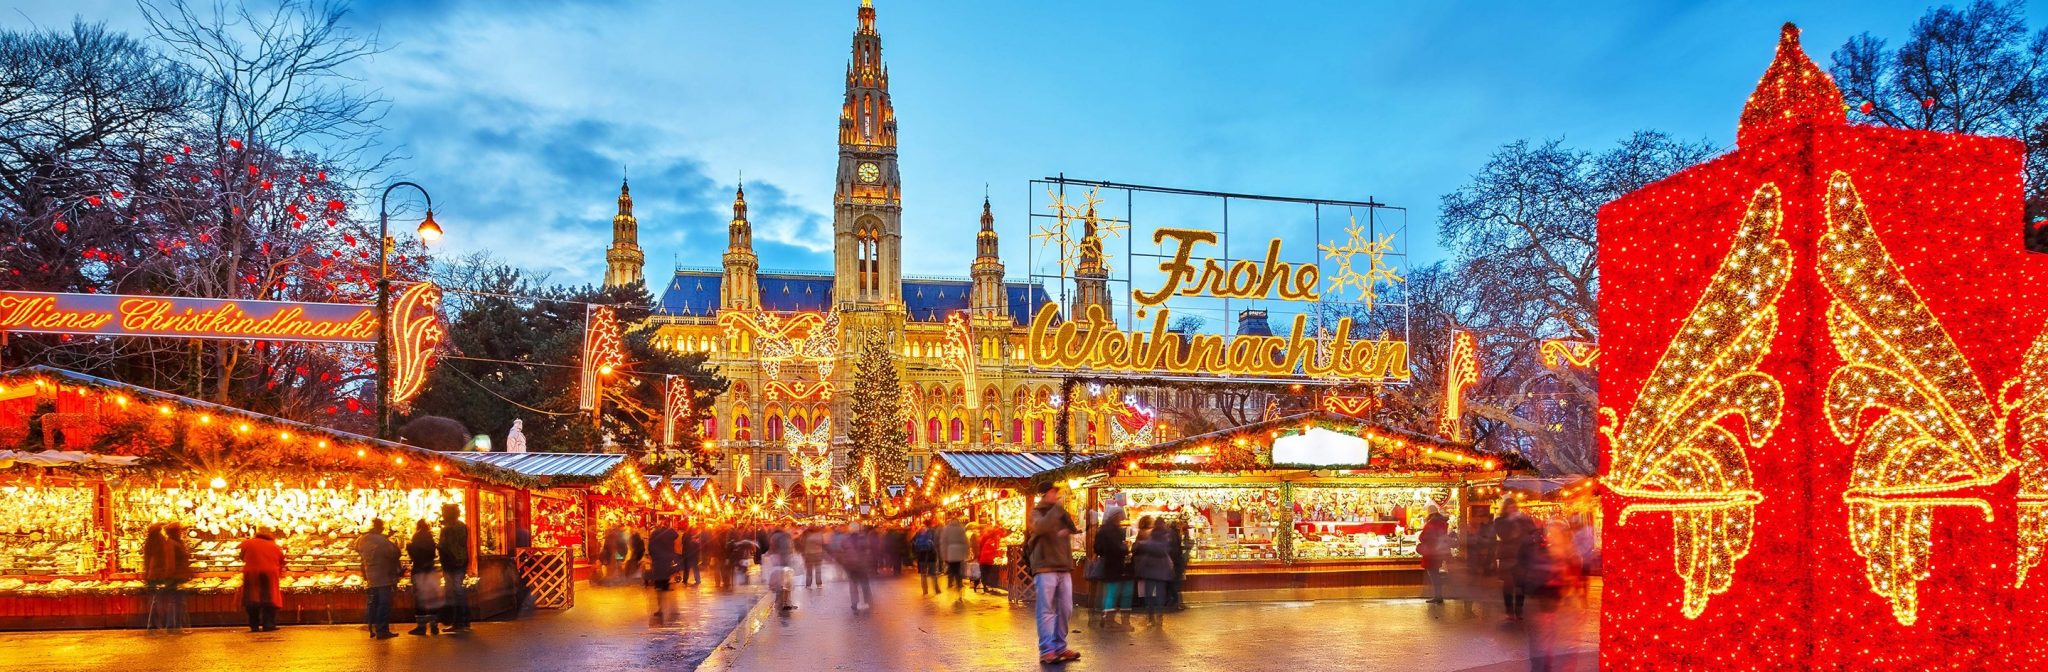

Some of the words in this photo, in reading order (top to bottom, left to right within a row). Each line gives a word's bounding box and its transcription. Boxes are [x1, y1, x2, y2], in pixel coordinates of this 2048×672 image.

[1133, 229, 1320, 305] Frohe
[0, 296, 112, 329] Wiener
[119, 299, 378, 338] Christkindlmarkt
[1029, 303, 1410, 379] Weihnachten
